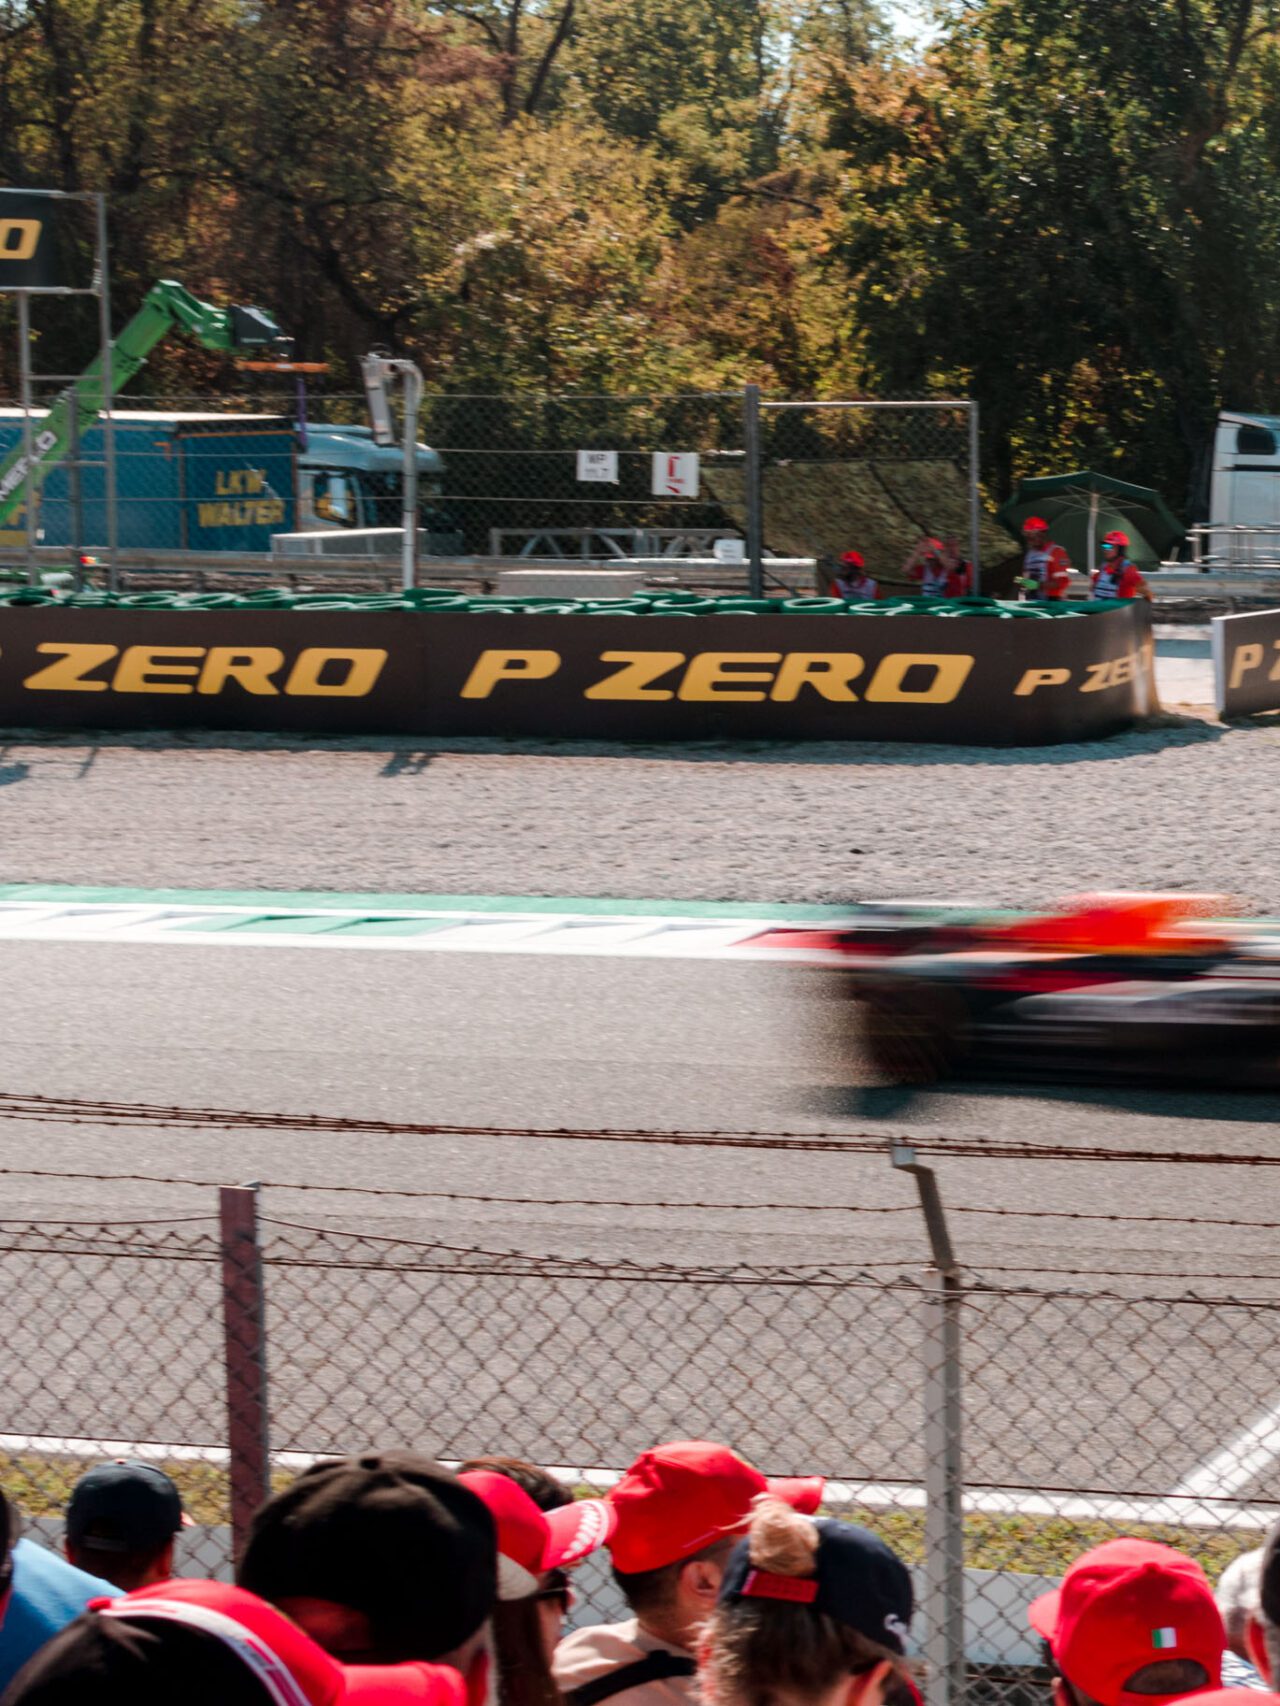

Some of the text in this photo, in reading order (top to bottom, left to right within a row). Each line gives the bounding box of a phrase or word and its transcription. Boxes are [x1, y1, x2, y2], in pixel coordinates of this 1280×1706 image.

[215, 469, 267, 495] LKW
[197, 500, 285, 528] WALTER
[23, 642, 388, 697] ZERO
[459, 649, 975, 703] P ZERO
[1013, 668, 1071, 695] P
[1228, 643, 1264, 688] P
